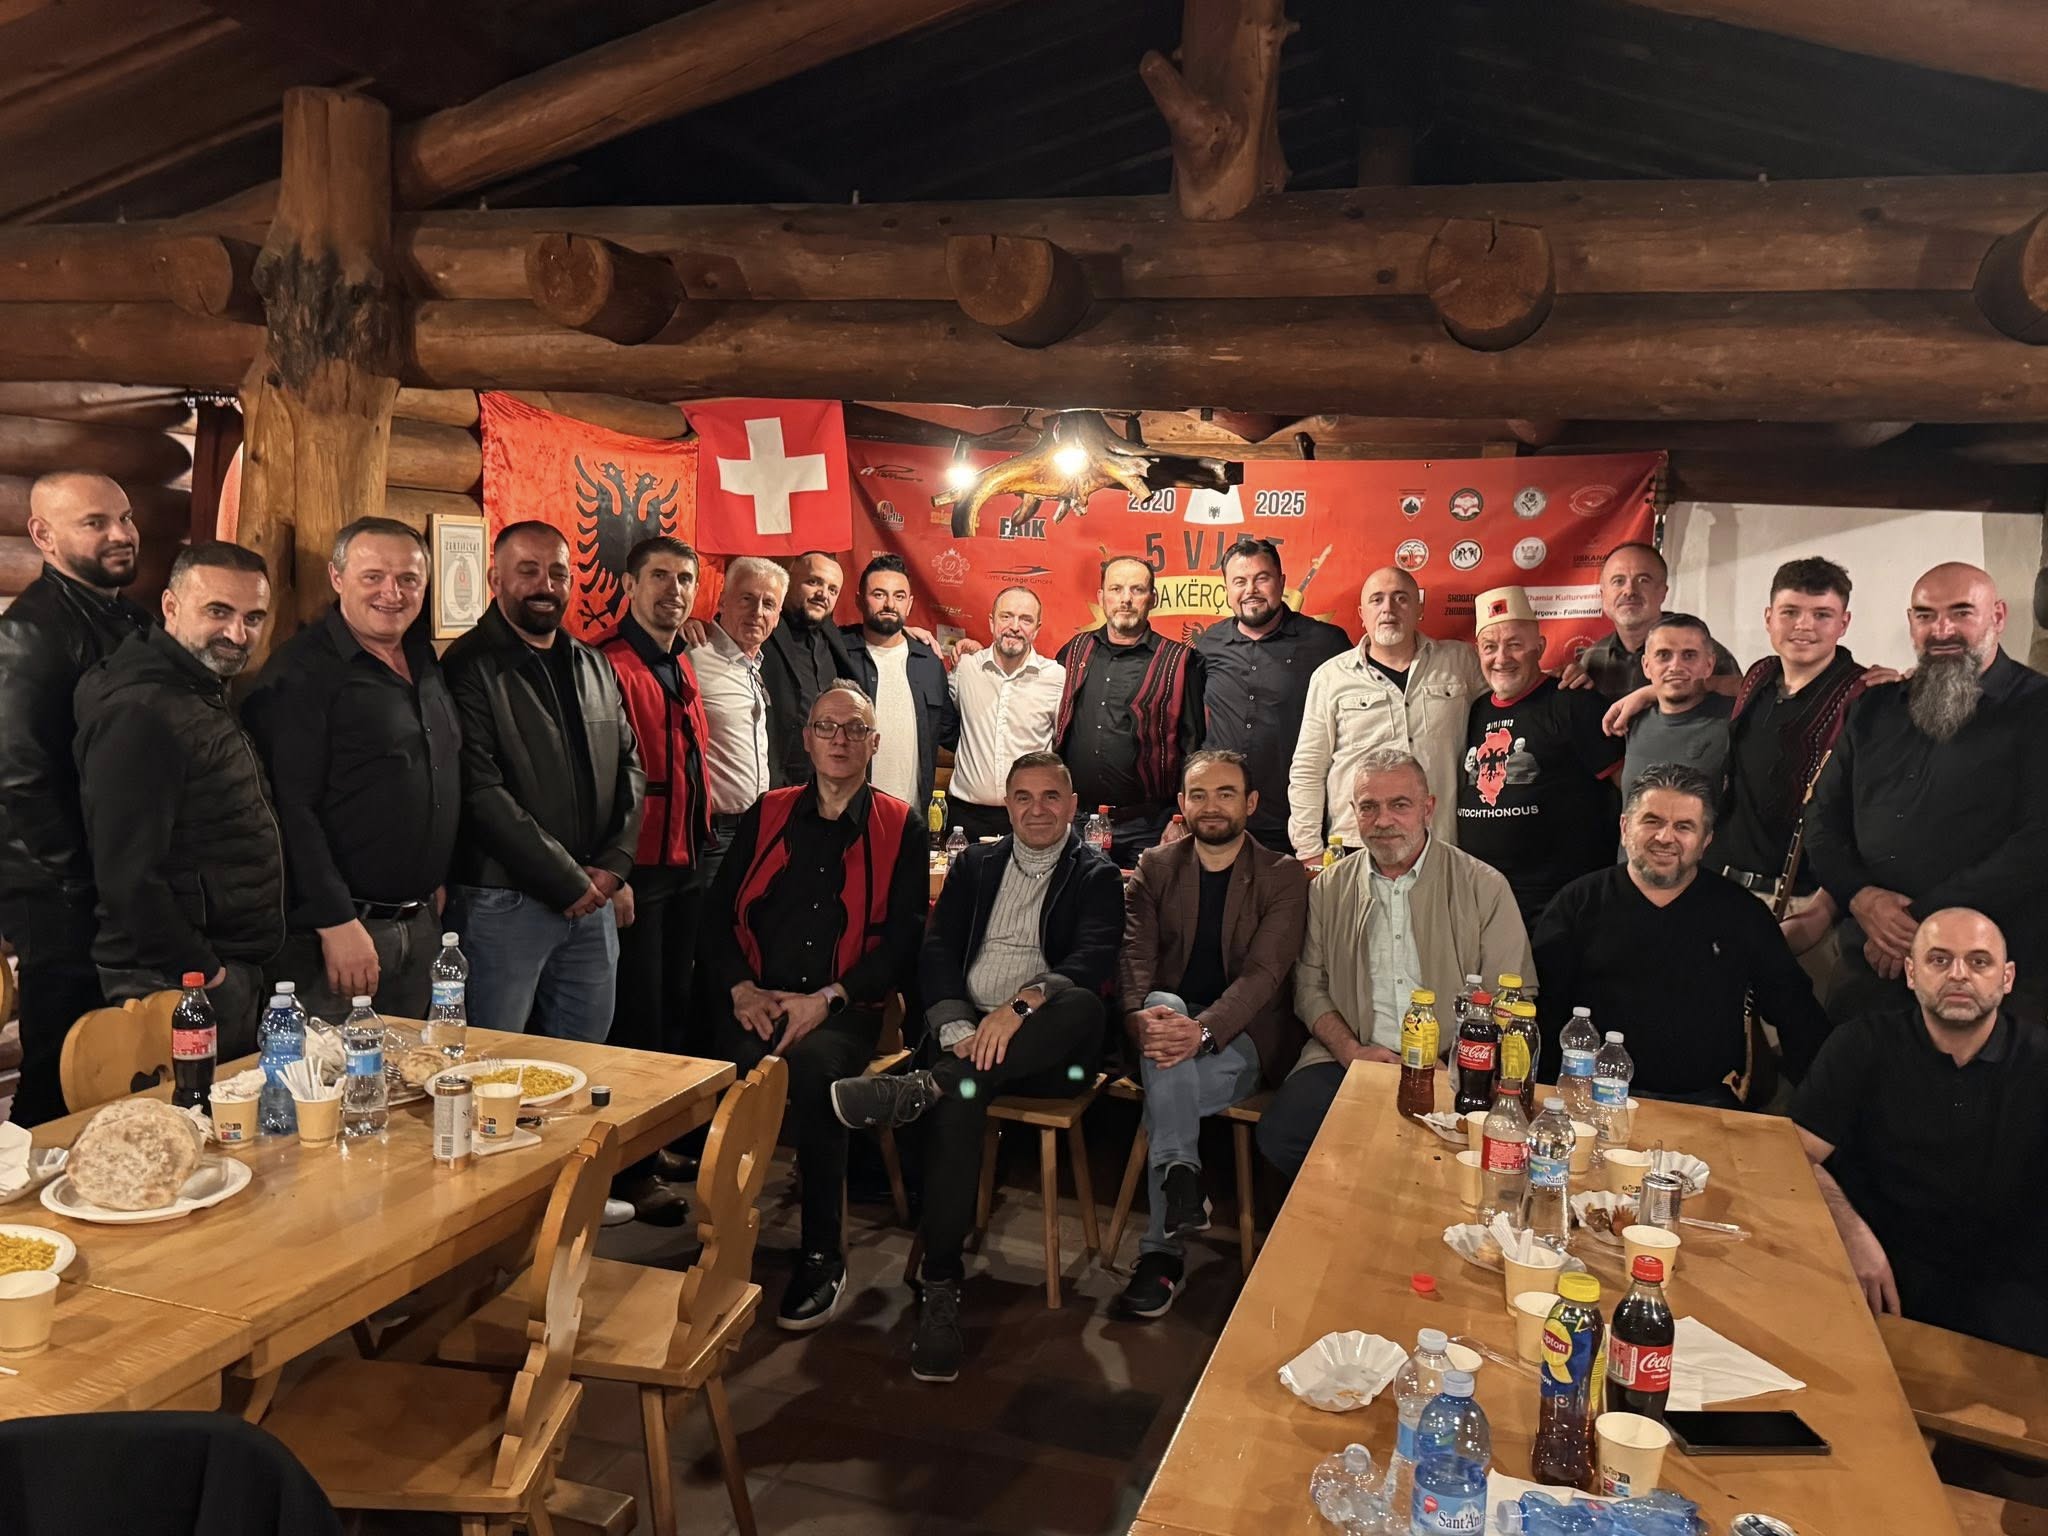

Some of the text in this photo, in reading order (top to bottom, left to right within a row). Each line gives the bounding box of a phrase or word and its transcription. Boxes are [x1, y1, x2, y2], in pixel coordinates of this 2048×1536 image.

[1255, 491, 1306, 515] 2025
[1145, 532, 1166, 572] 5
[1175, 578, 1231, 615] KËRÇ
